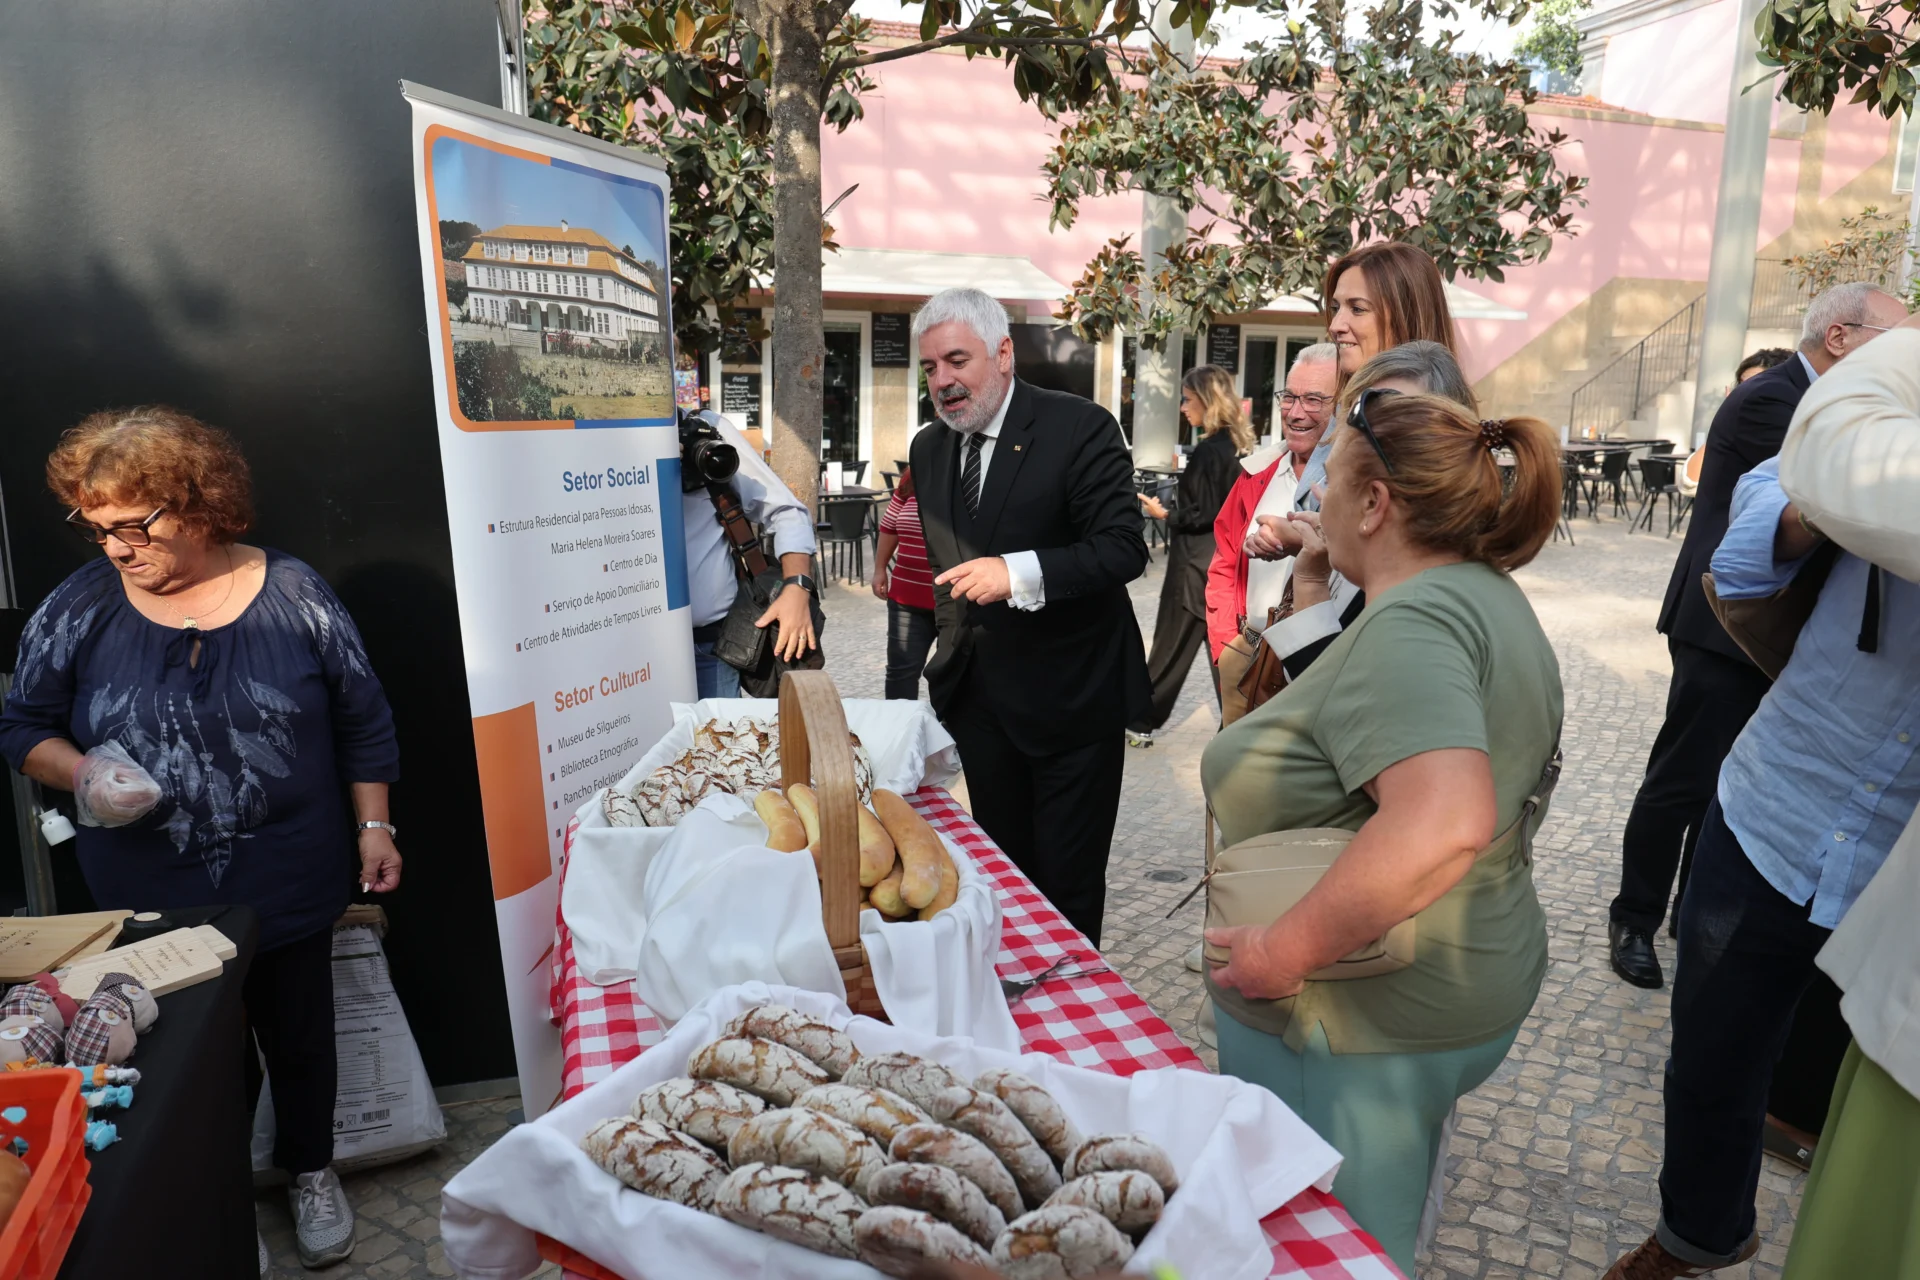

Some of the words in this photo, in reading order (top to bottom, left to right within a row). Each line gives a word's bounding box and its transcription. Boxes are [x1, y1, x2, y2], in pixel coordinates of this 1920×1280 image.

[563, 471, 603, 492] Setor
[607, 465, 650, 488] Social
[499, 519, 534, 534] Estrutura
[535, 510, 581, 528] Residencial
[583, 511, 600, 525] para
[600, 507, 627, 519] Pessoas
[627, 503, 654, 515] Idosas,
[551, 540, 574, 555] Maria
[576, 537, 603, 551] Helena
[604, 532, 630, 545] Moreira
[630, 529, 656, 541] Soares
[610, 559, 633, 572] Centro
[634, 555, 644, 567] de
[644, 553, 658, 565] Dia
[552, 596, 583, 613] Serviço
[583, 592, 594, 605] de
[595, 588, 617, 605] Apoio
[617, 578, 660, 597] Domiciliário
[523, 636, 549, 651] Centro
[549, 629, 560, 643] de
[561, 619, 603, 639] Atividades
[603, 616, 613, 628] de
[613, 609, 640, 624] Tempos
[640, 604, 662, 618] Livres
[554, 684, 595, 712] Setor
[599, 662, 651, 697] Cultural
[557, 732, 584, 750] Museu
[585, 727, 595, 740] de
[596, 713, 631, 735] Silgueiros
[560, 754, 599, 779] Biblioteca
[599, 736, 639, 762] Etnográfica
[563, 783, 592, 805] Rancho
[593, 768, 628, 793] Folclórico
